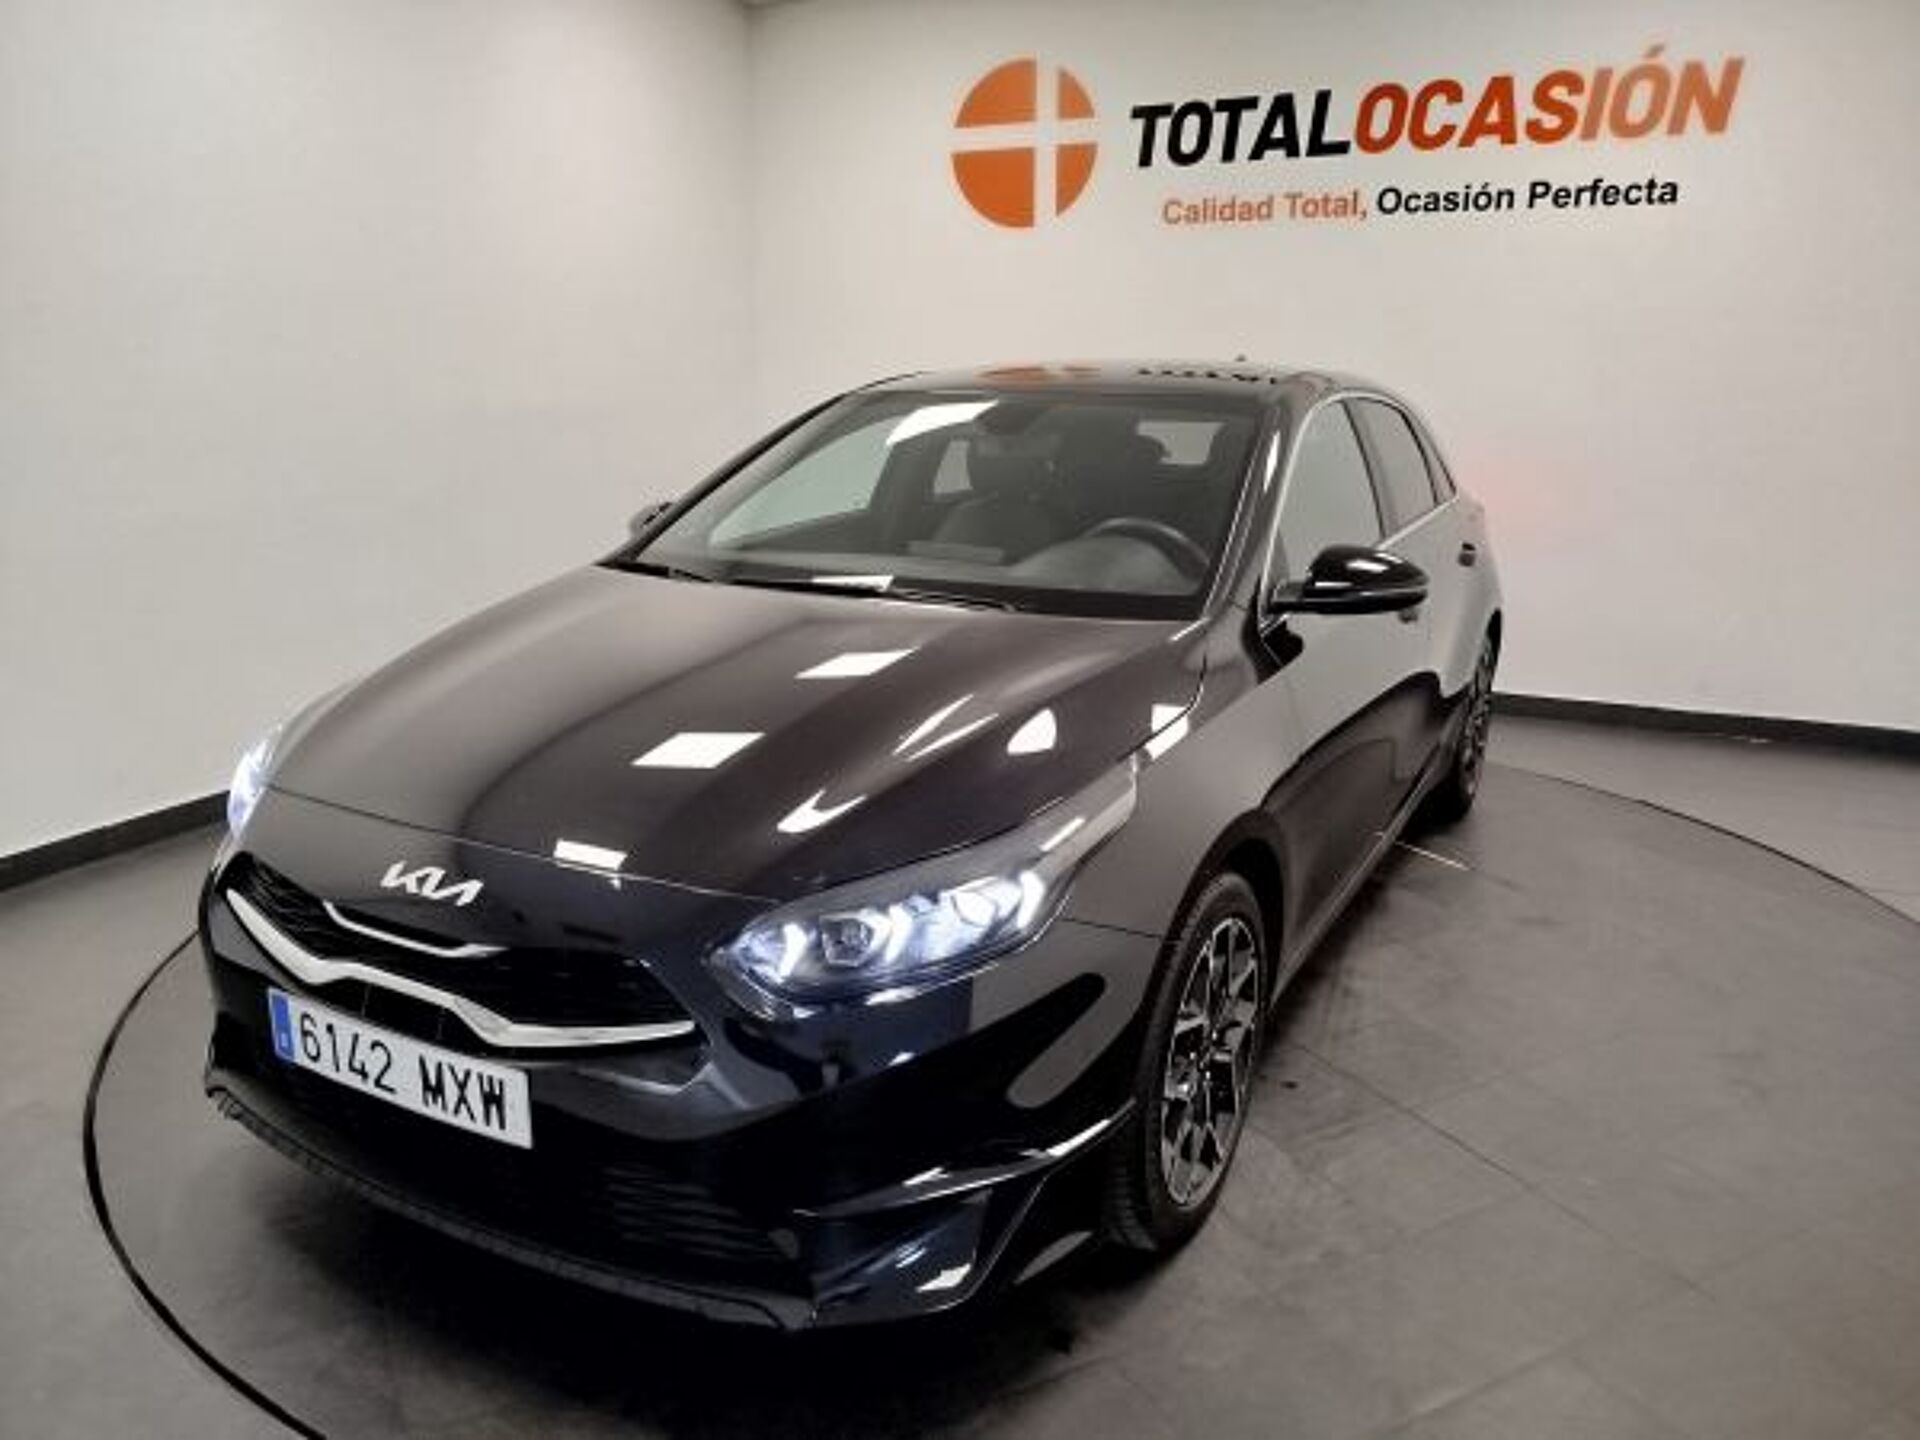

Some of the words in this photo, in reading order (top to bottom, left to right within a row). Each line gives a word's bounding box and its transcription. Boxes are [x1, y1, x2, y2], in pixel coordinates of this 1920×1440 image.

[1163, 193, 1273, 225] Calidad
[1285, 189, 1368, 221] Total,
[1377, 183, 1515, 215] Ocasión
[1528, 176, 1679, 208] Perfecta
[300, 1013, 397, 1094] 6142
[419, 1055, 507, 1131] MXW
